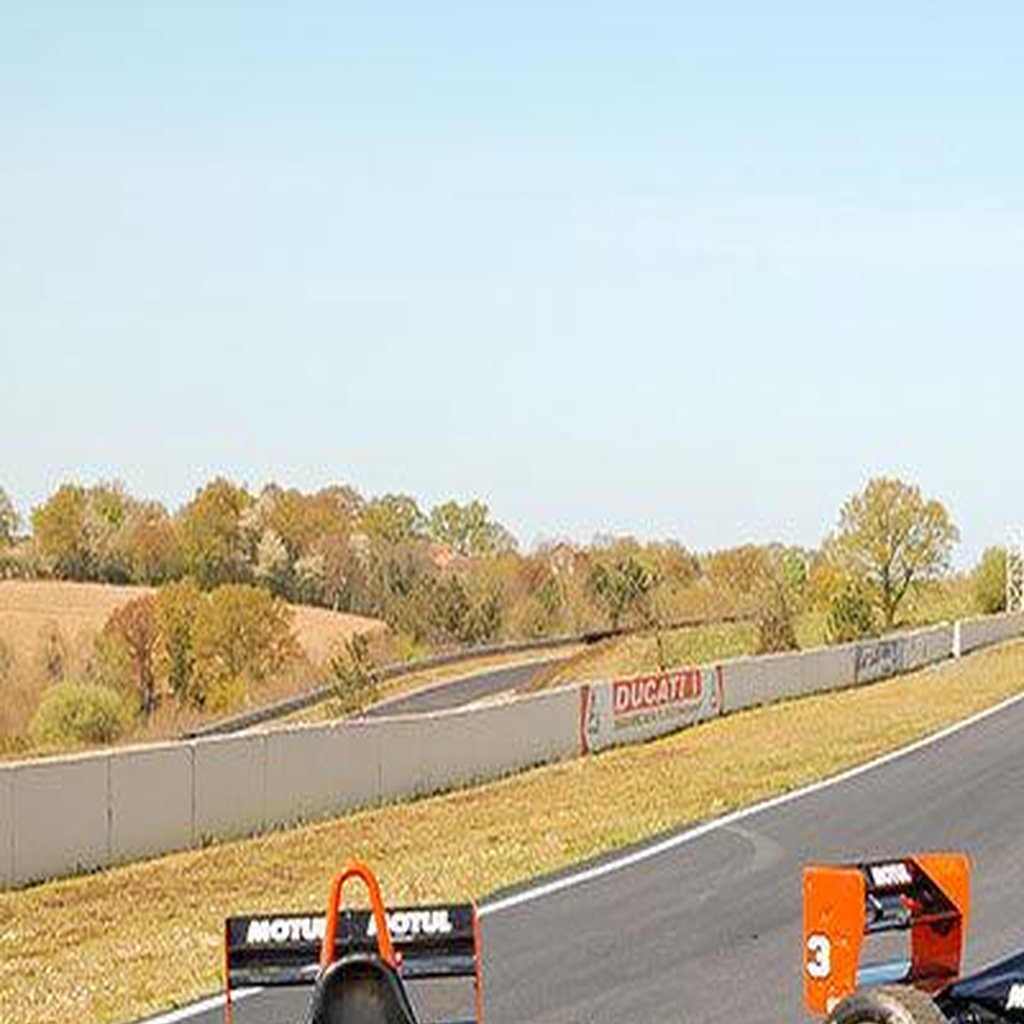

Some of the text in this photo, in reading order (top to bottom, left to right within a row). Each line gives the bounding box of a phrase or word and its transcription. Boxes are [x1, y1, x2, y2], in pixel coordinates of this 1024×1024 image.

[616, 672, 687, 711] DUCATI
[247, 917, 328, 943] MOTU
[806, 934, 831, 977] 3
